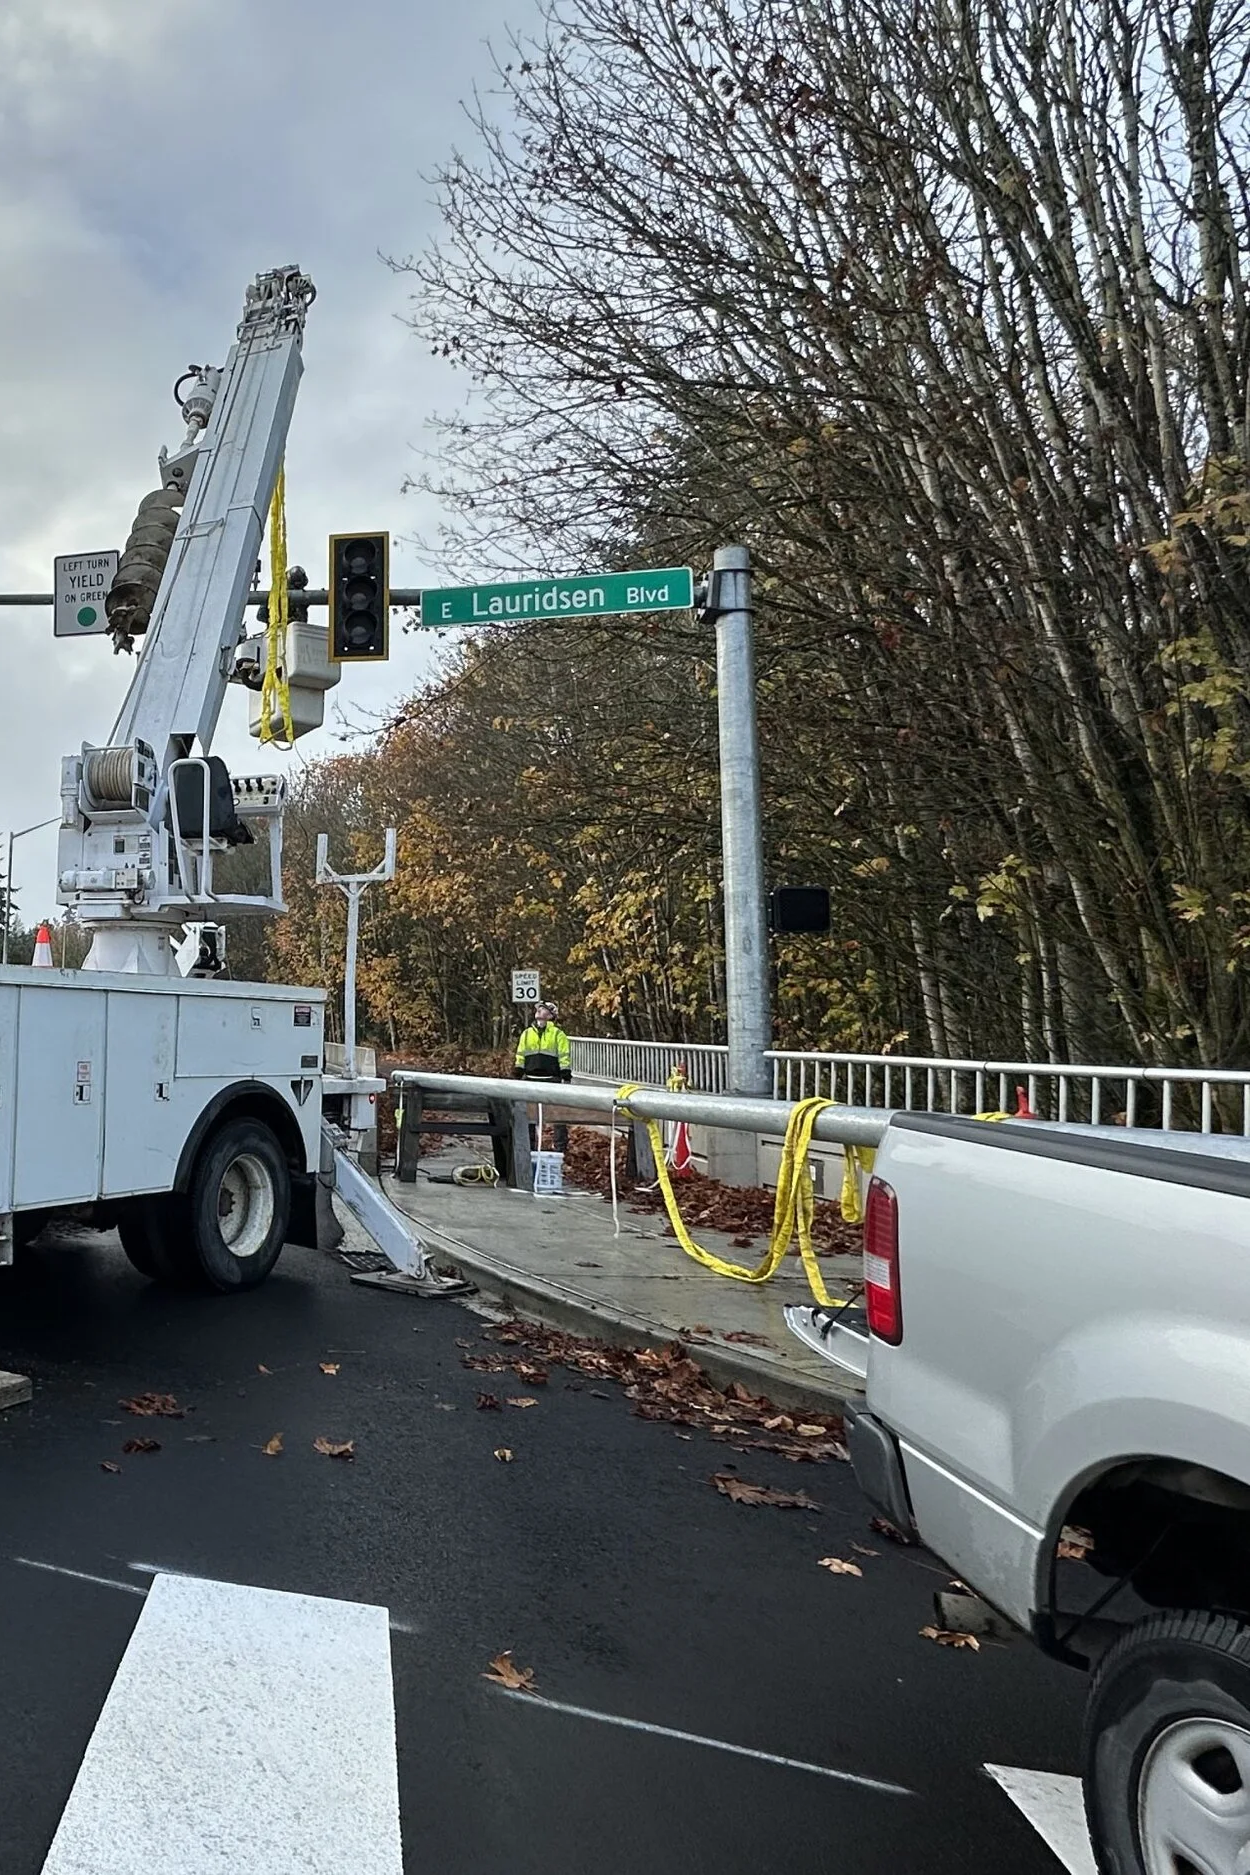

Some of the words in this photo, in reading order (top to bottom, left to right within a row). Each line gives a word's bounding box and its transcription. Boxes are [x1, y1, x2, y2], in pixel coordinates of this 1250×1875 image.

[63, 561, 83, 572] LEFT
[87, 558, 110, 569] TURN
[69, 573, 104, 588] YIELD
[64, 594, 76, 603] ON
[80, 591, 108, 602] GREEN
[441, 602, 452, 618] E
[473, 586, 604, 616] Lauridsen
[626, 585, 669, 604] Blvd
[515, 987, 537, 999] 30
